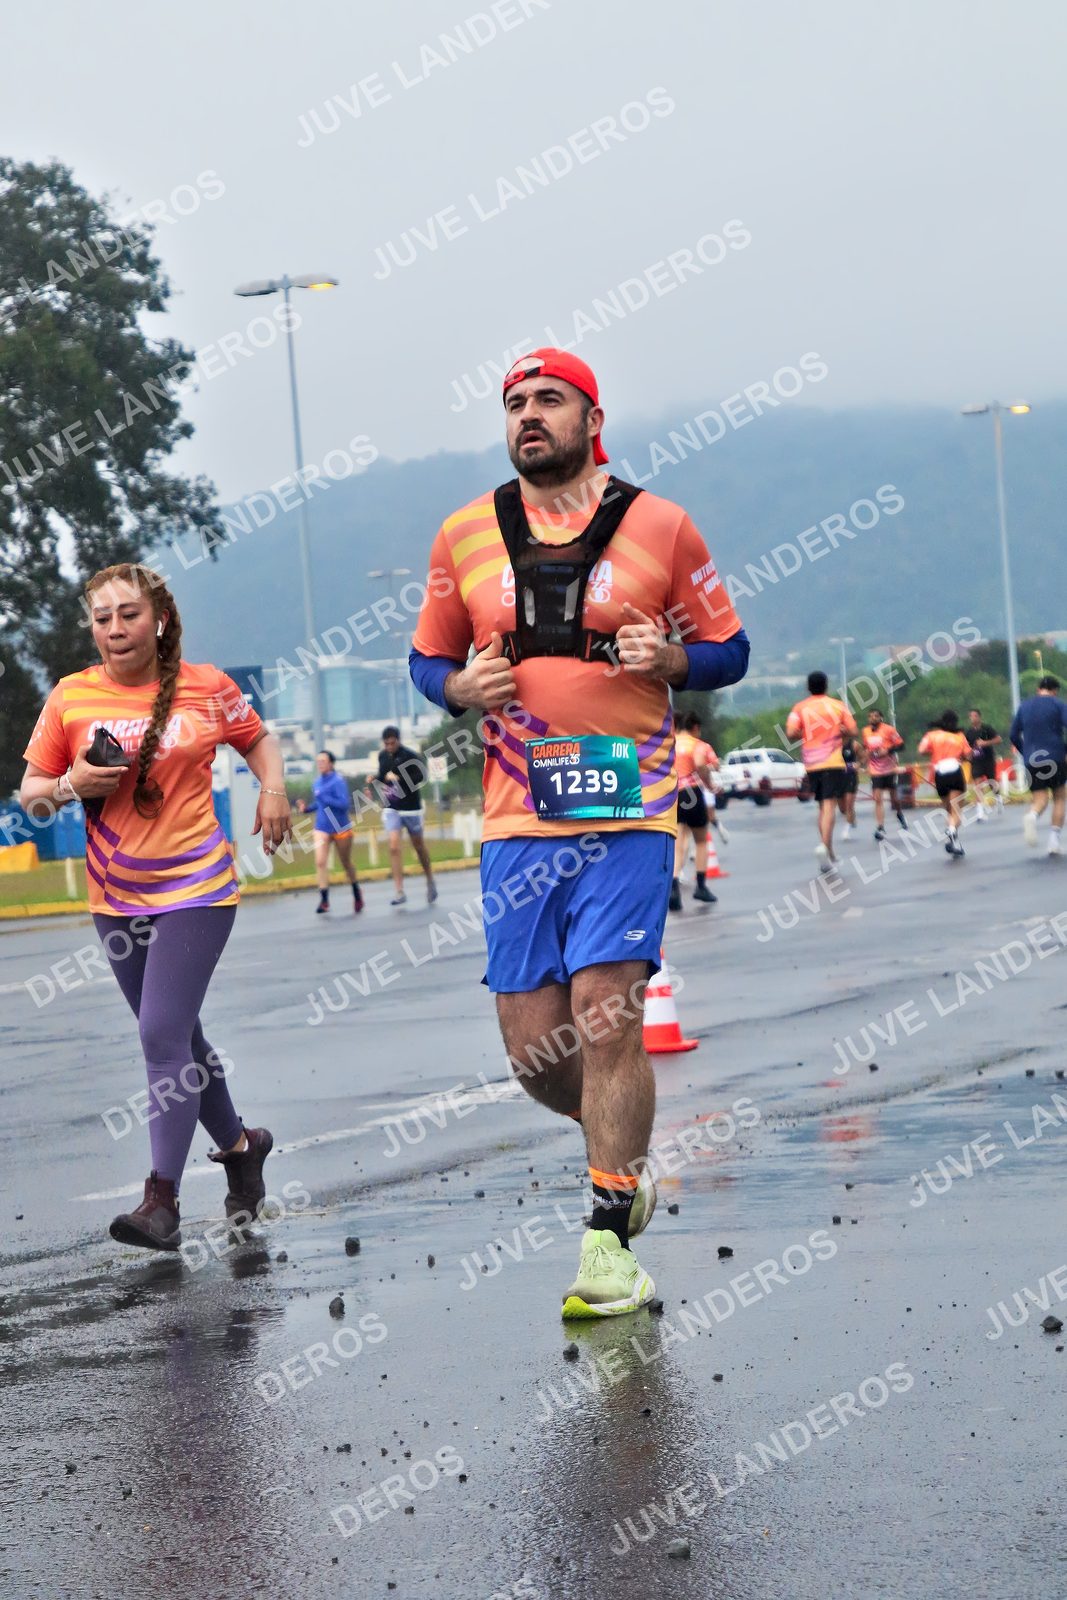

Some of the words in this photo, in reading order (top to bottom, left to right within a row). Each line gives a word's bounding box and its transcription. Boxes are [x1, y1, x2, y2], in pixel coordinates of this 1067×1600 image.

[533, 743, 580, 759] CARRERA
[612, 742, 629, 759] 10K
[550, 769, 618, 795] 1239
